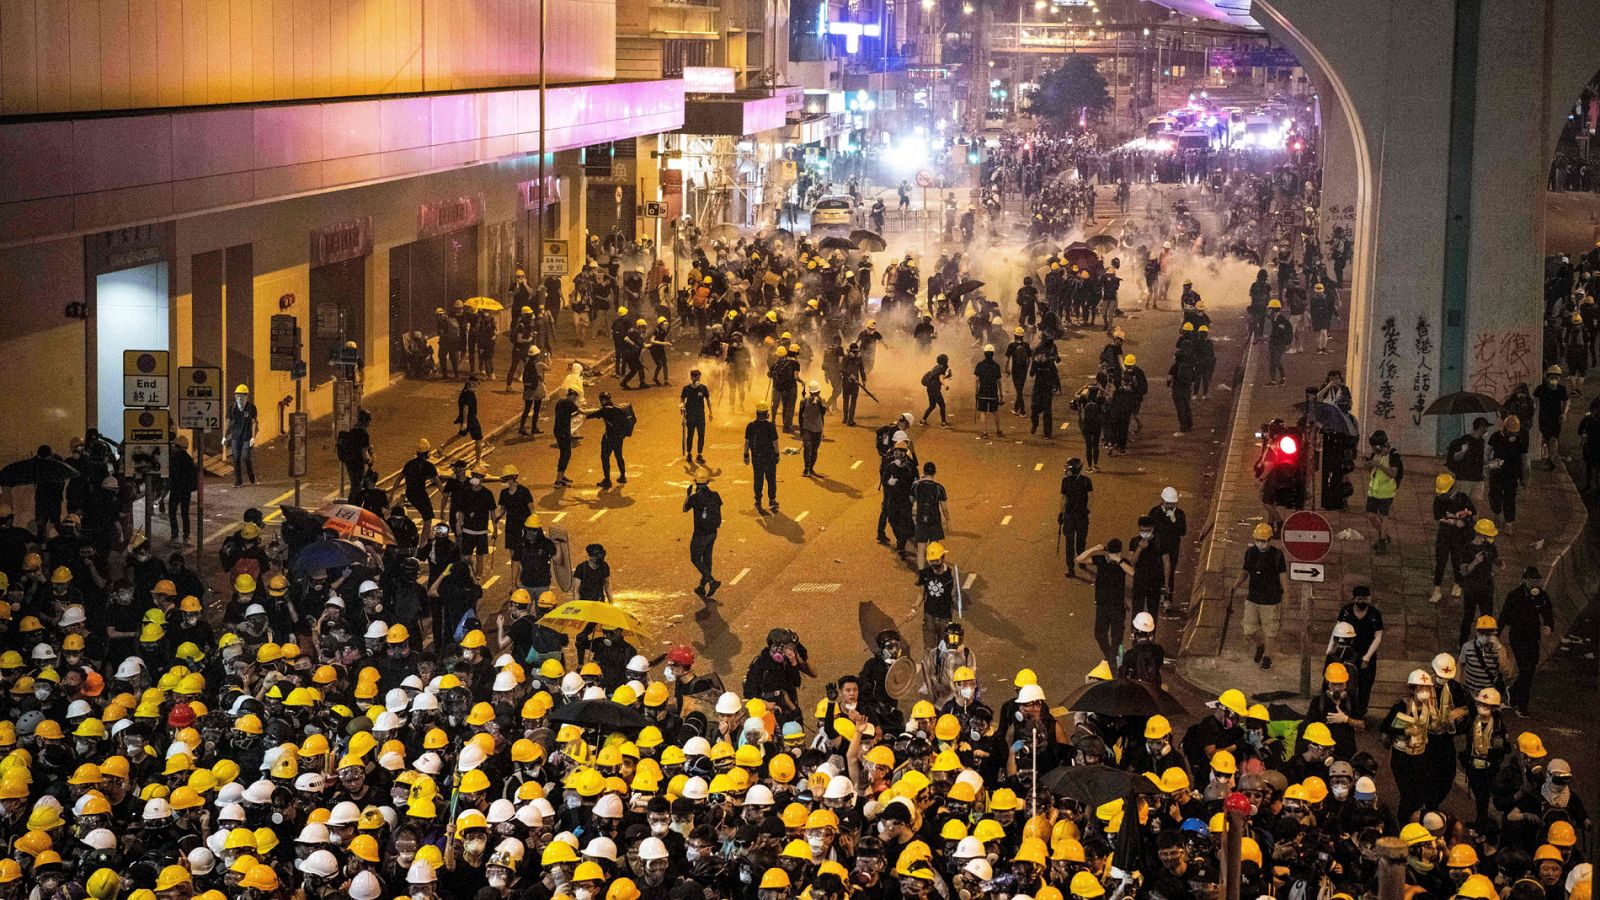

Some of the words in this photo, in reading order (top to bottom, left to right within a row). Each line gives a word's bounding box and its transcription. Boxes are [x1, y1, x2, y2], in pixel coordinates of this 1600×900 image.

[137, 379, 157, 388] End
[132, 391, 160, 403] 終止
[205, 402, 212, 411] 7
[205, 417, 218, 427] 12
